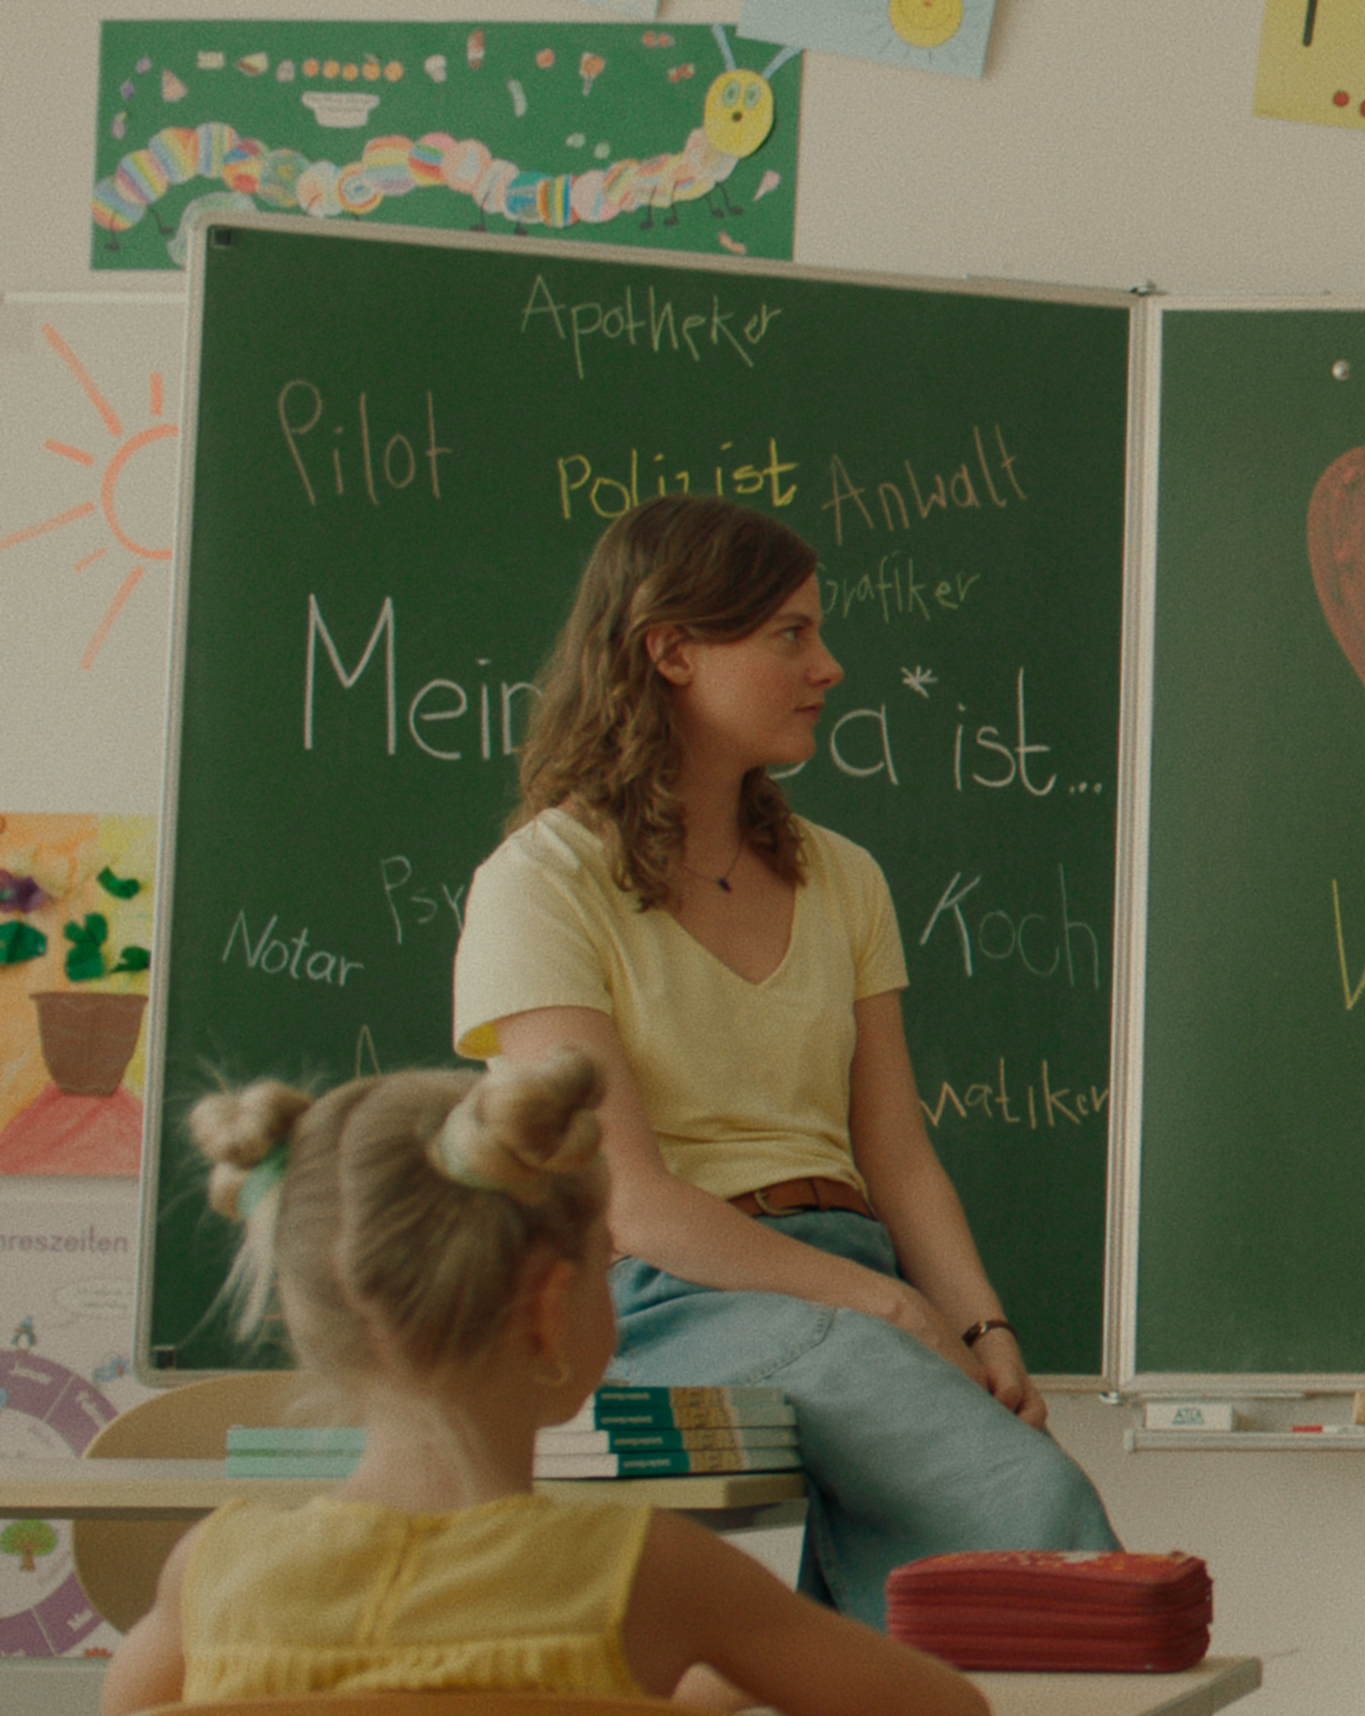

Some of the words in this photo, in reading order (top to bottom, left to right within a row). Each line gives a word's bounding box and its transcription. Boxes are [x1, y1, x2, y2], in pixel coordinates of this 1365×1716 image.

[520, 274, 782, 379] Apotheker
[279, 379, 453, 505] Pilot
[822, 424, 1027, 546] Anwalt
[222, 908, 364, 986] Notar
[920, 862, 1099, 989] Koch
